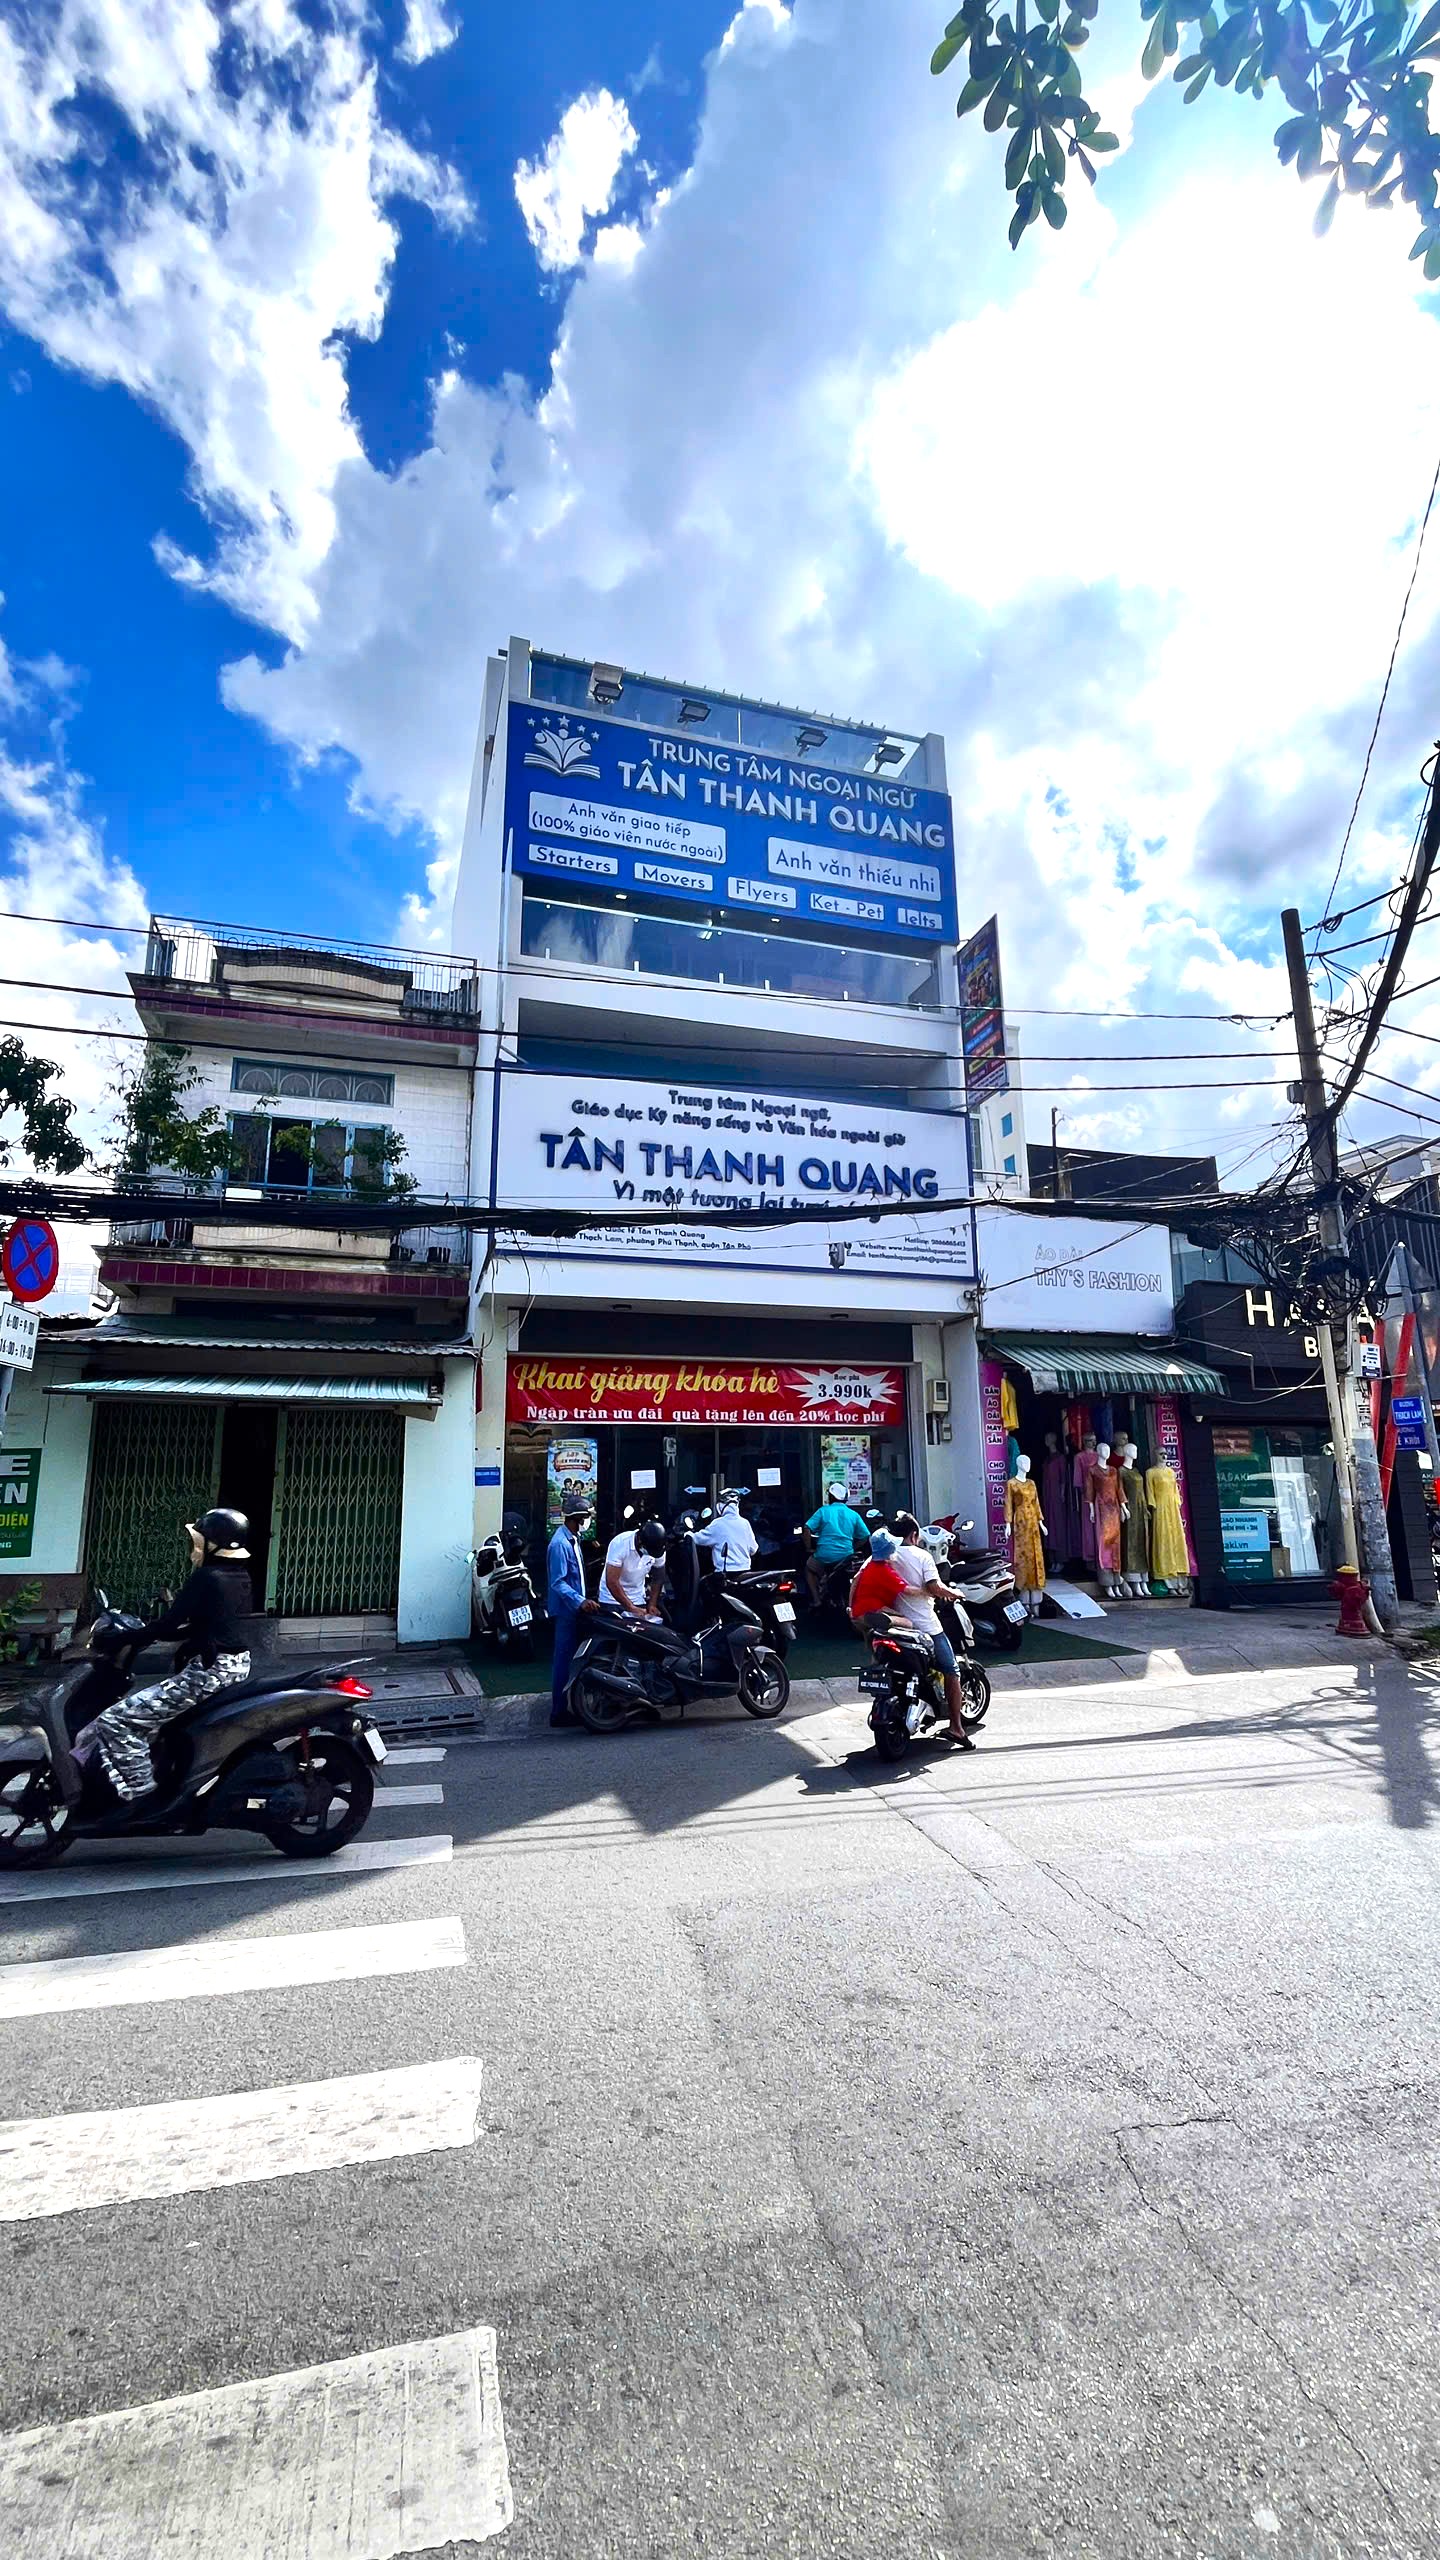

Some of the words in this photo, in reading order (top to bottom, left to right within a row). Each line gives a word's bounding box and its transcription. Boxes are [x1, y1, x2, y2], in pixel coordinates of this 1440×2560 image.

[649, 738, 731, 772] TRUNG
[735, 755, 782, 784] TÂM
[789, 768, 860, 801] NGOẠI
[867, 785, 917, 809] NGỮ
[617, 759, 687, 800] TÂN
[699, 777, 818, 825] THANH
[829, 805, 946, 848] QUANG
[568, 803, 596, 819] Anh
[601, 810, 626, 824] văn
[631, 816, 661, 830] giao
[665, 821, 691, 838] tiếp
[532, 811, 575, 833] (100%
[579, 824, 610, 838] giáo
[614, 830, 642, 844] viên
[645, 838, 677, 851] nước
[680, 843, 724, 861] ngoài)
[536, 847, 611, 873] Starters
[775, 849, 812, 871] Anh
[819, 859, 852, 878] văn
[858, 863, 903, 887] thiếu
[909, 873, 935, 893] nhi
[642, 865, 706, 889] Movers
[735, 880, 789, 904] Flyers
[812, 894, 839, 911] Ket
[856, 902, 883, 919] Pet
[904, 909, 936, 928] Ielts
[668, 1089, 713, 1111] Trung
[717, 1096, 747, 1111] tâm
[751, 1098, 797, 1118] Ngoại
[571, 1099, 610, 1117] Giáo
[614, 1103, 643, 1122] dục
[648, 1106, 669, 1126] Kỹ
[672, 1111, 713, 1130] năng
[716, 1114, 751, 1134] sống
[756, 1119, 774, 1133] và
[778, 1119, 806, 1136] Văn
[810, 1122, 837, 1139] hóa
[841, 1129, 880, 1144] ngoài
[883, 1133, 906, 1148] giờ
[540, 1126, 625, 1174] TÂN
[639, 1141, 785, 1187] THANH
[799, 1157, 939, 1199] QUANG
[654, 1228, 678, 1237] Thanh
[680, 1230, 706, 1240] Quang
[1034, 1267, 1085, 1288] THY'S
[1088, 1270, 1162, 1292] FASHION
[512, 1361, 586, 1391] Khai
[590, 1364, 673, 1404] giảng
[675, 1364, 747, 1393] khóa
[749, 1367, 781, 1394] hè
[818, 1384, 873, 1399] 3.990k
[984, 1385, 999, 1395] BÁN
[987, 1397, 999, 1407] ÁO
[526, 1405, 568, 1422] Ngập
[573, 1406, 608, 1419] tràn
[613, 1408, 633, 1419] ưu
[637, 1407, 663, 1420] đãi
[672, 1408, 700, 1422] quà
[705, 1408, 738, 1423] tặng
[742, 1408, 765, 1421] lên
[768, 1408, 795, 1421] đến
[799, 1410, 831, 1422] 20%
[834, 1410, 856, 1424] học
[862, 1410, 885, 1423] phí
[986, 1424, 1002, 1432] MAY
[1162, 1424, 1177, 1433] MAY
[988, 1460, 1004, 1469] CHO
[1165, 1460, 1181, 1468] CHO
[993, 1483, 1004, 1493] ÁO
